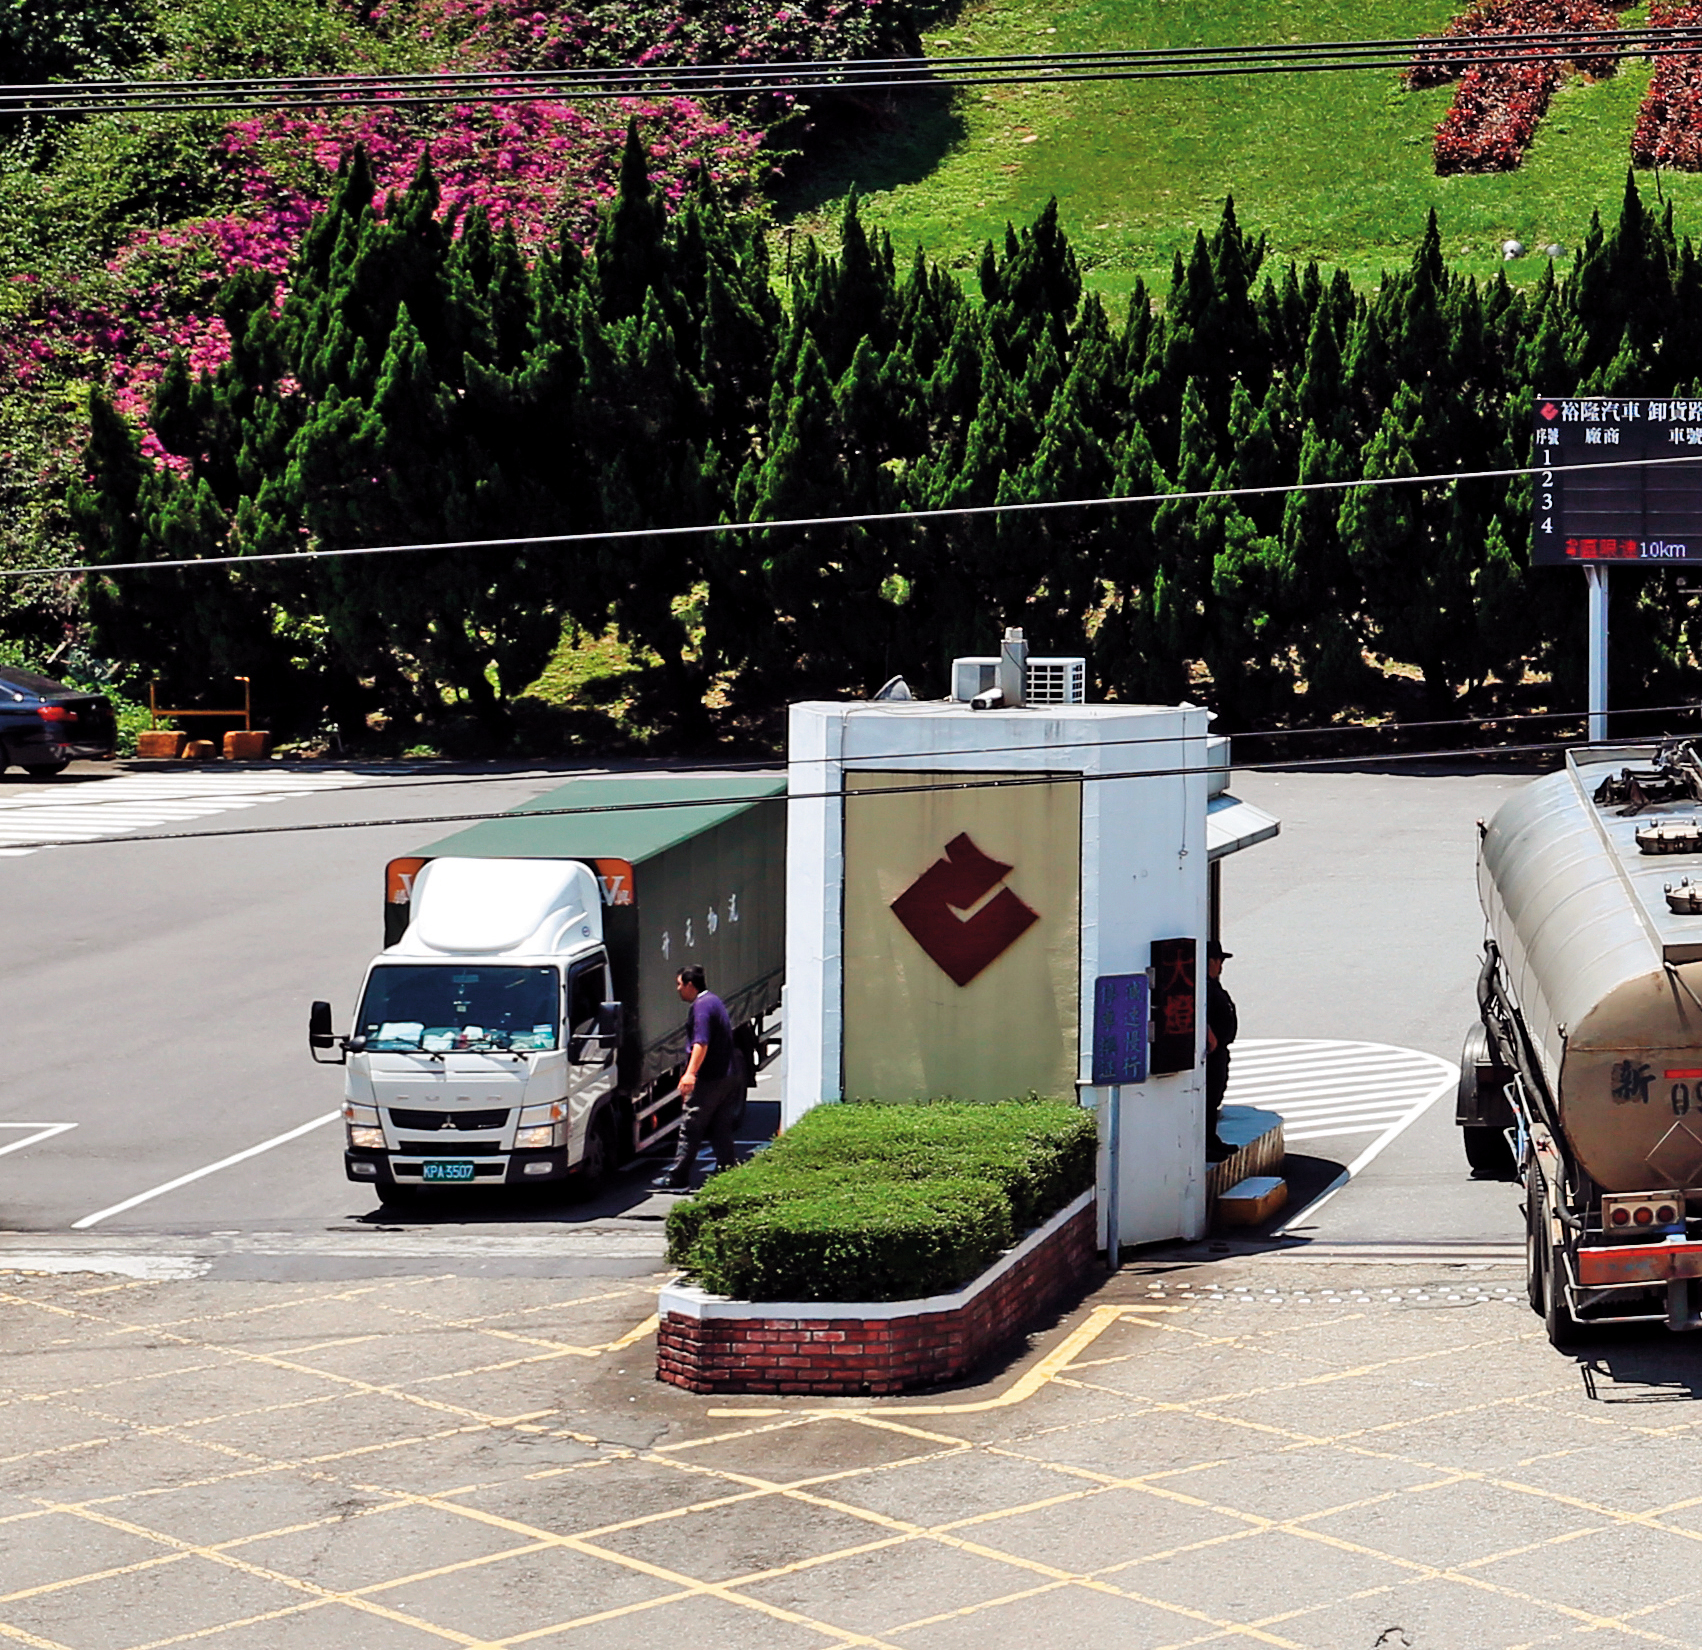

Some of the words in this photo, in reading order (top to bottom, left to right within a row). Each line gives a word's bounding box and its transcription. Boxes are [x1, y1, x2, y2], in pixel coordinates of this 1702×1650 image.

[1561, 401, 1641, 423] 裕隆汽車
[1535, 428, 1560, 446] 序號
[1585, 427, 1620, 445] 廠商
[1543, 450, 1551, 465] 1
[1541, 470, 1553, 488] 2
[1541, 493, 1553, 511] 3
[1541, 517, 1553, 534] 4
[1123, 980, 1142, 1079] 減速慢行
